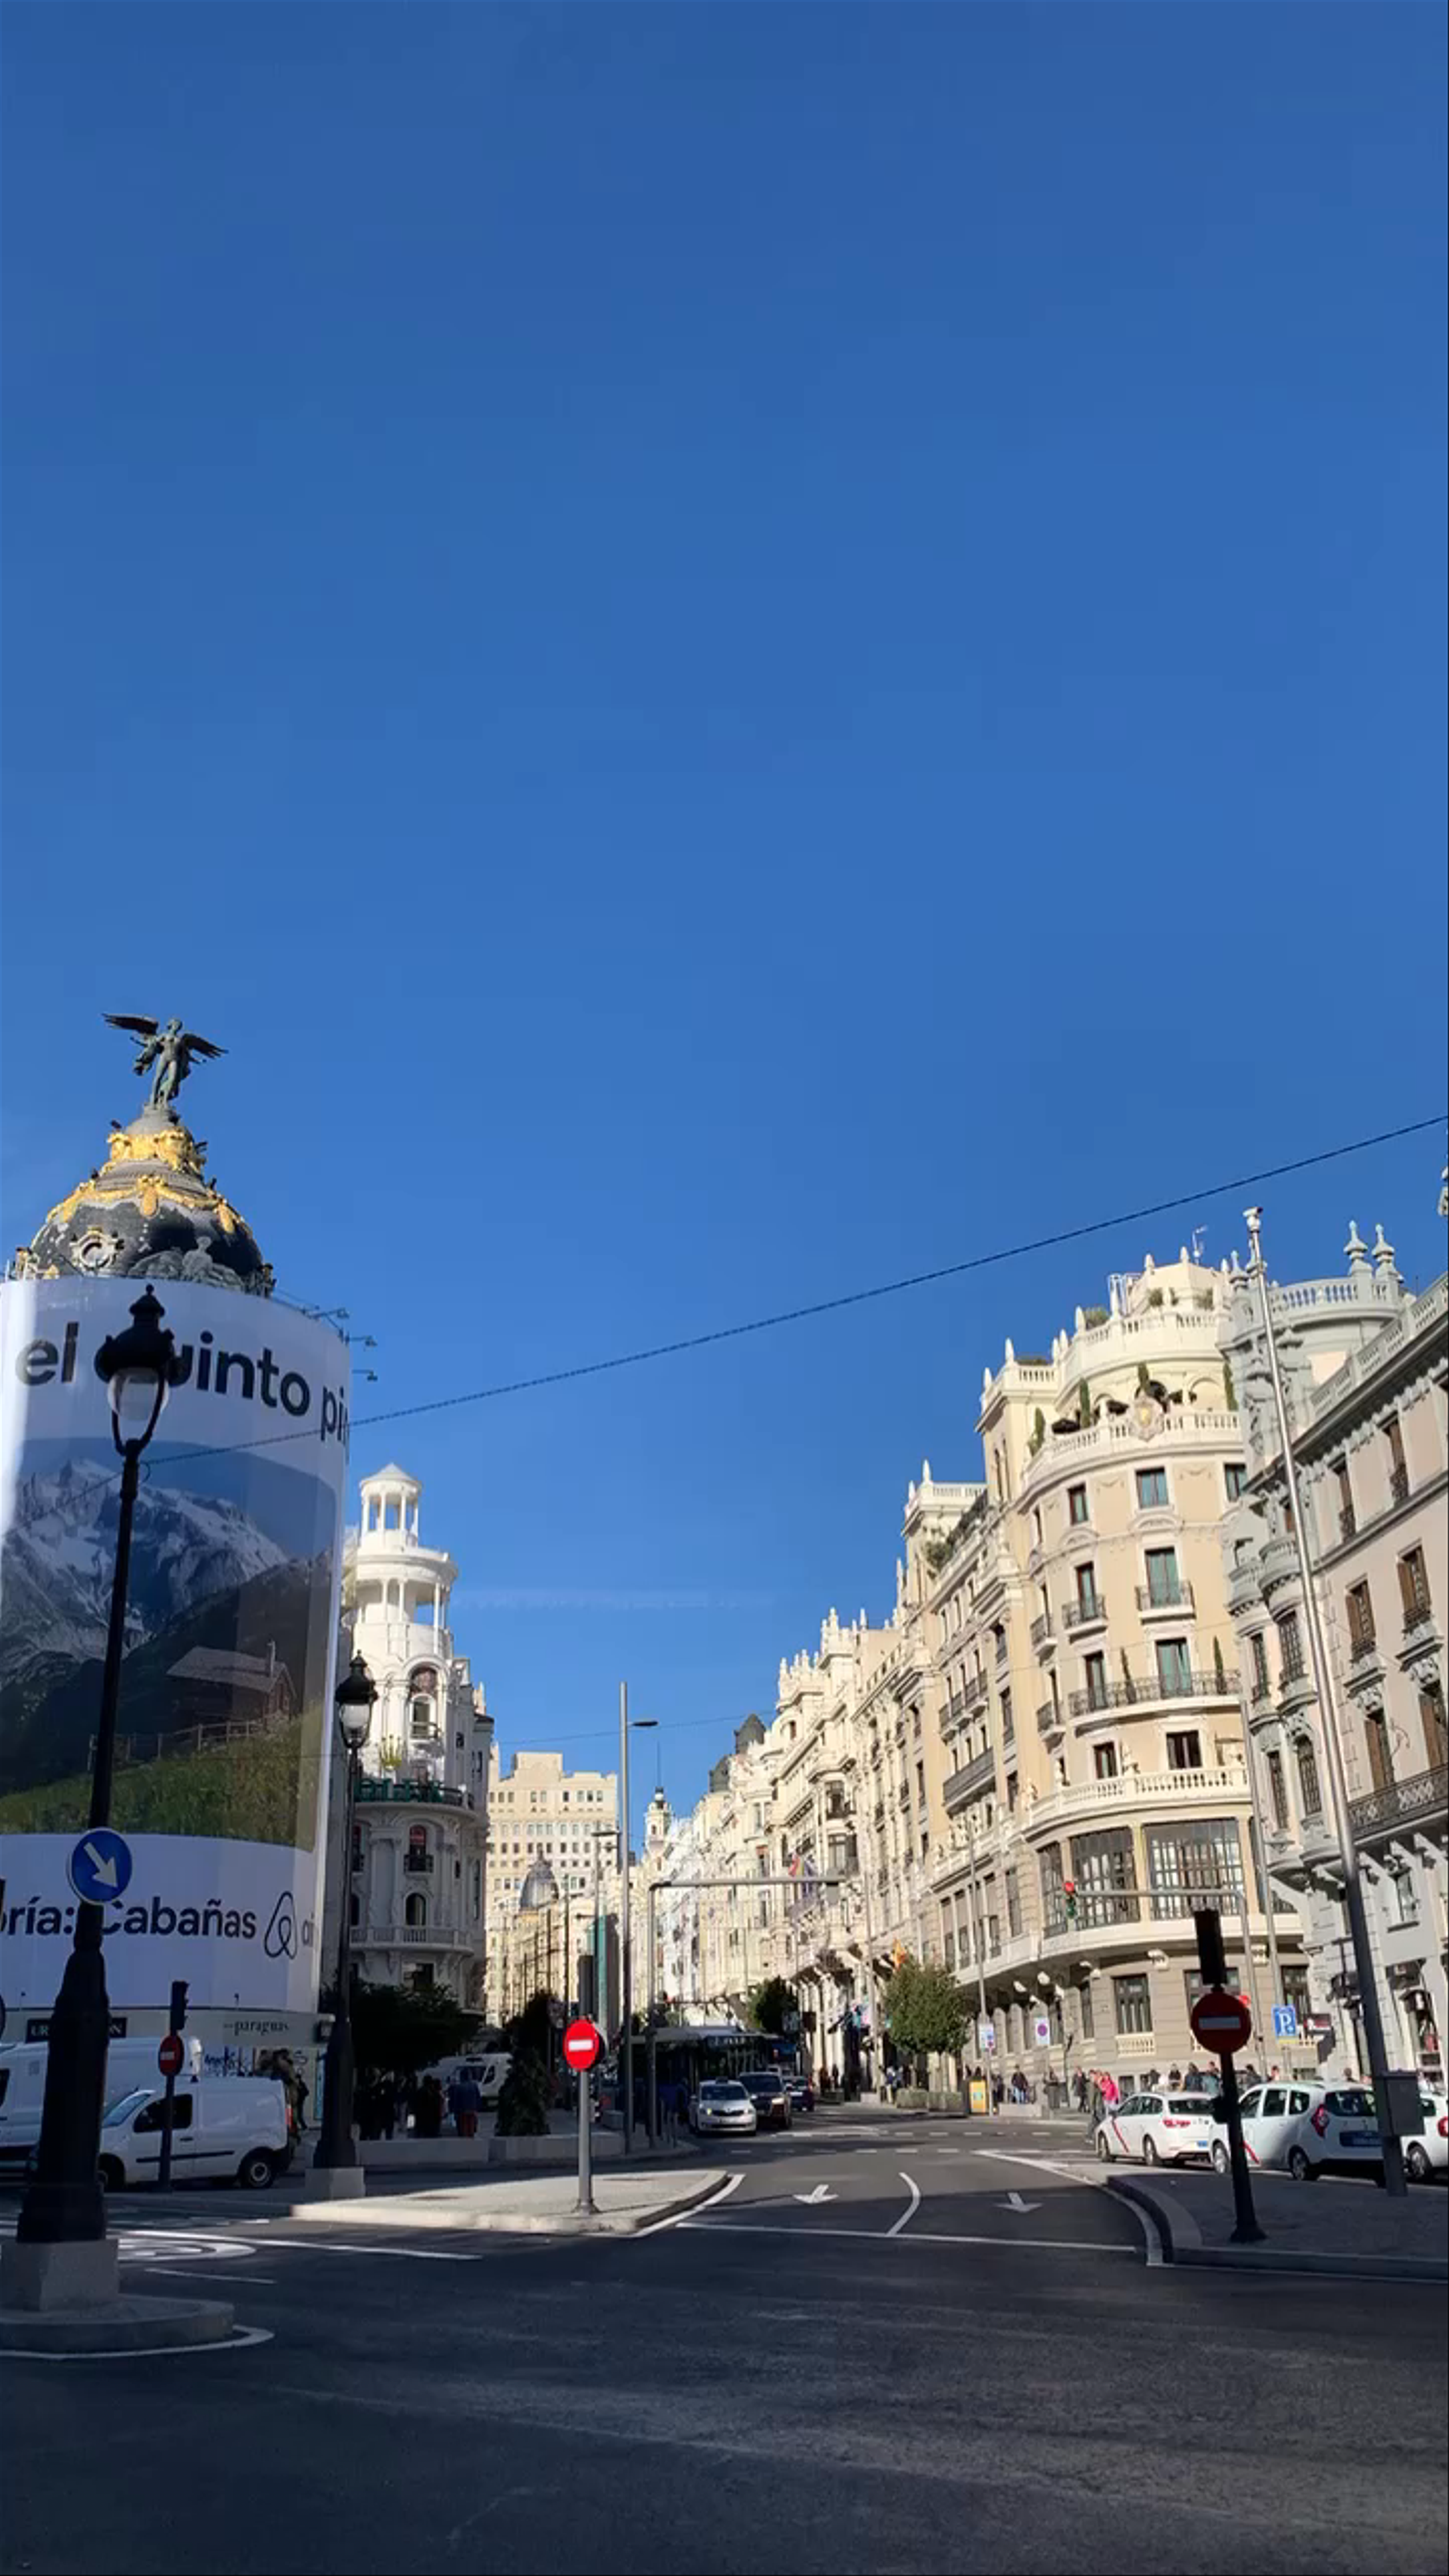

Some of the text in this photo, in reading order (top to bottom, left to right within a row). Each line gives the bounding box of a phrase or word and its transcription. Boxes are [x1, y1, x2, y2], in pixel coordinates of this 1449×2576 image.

[15, 1322, 79, 1385] el
[130, 1331, 311, 1416] uinto
[0, 1896, 256, 1939] ría: Cabañas
